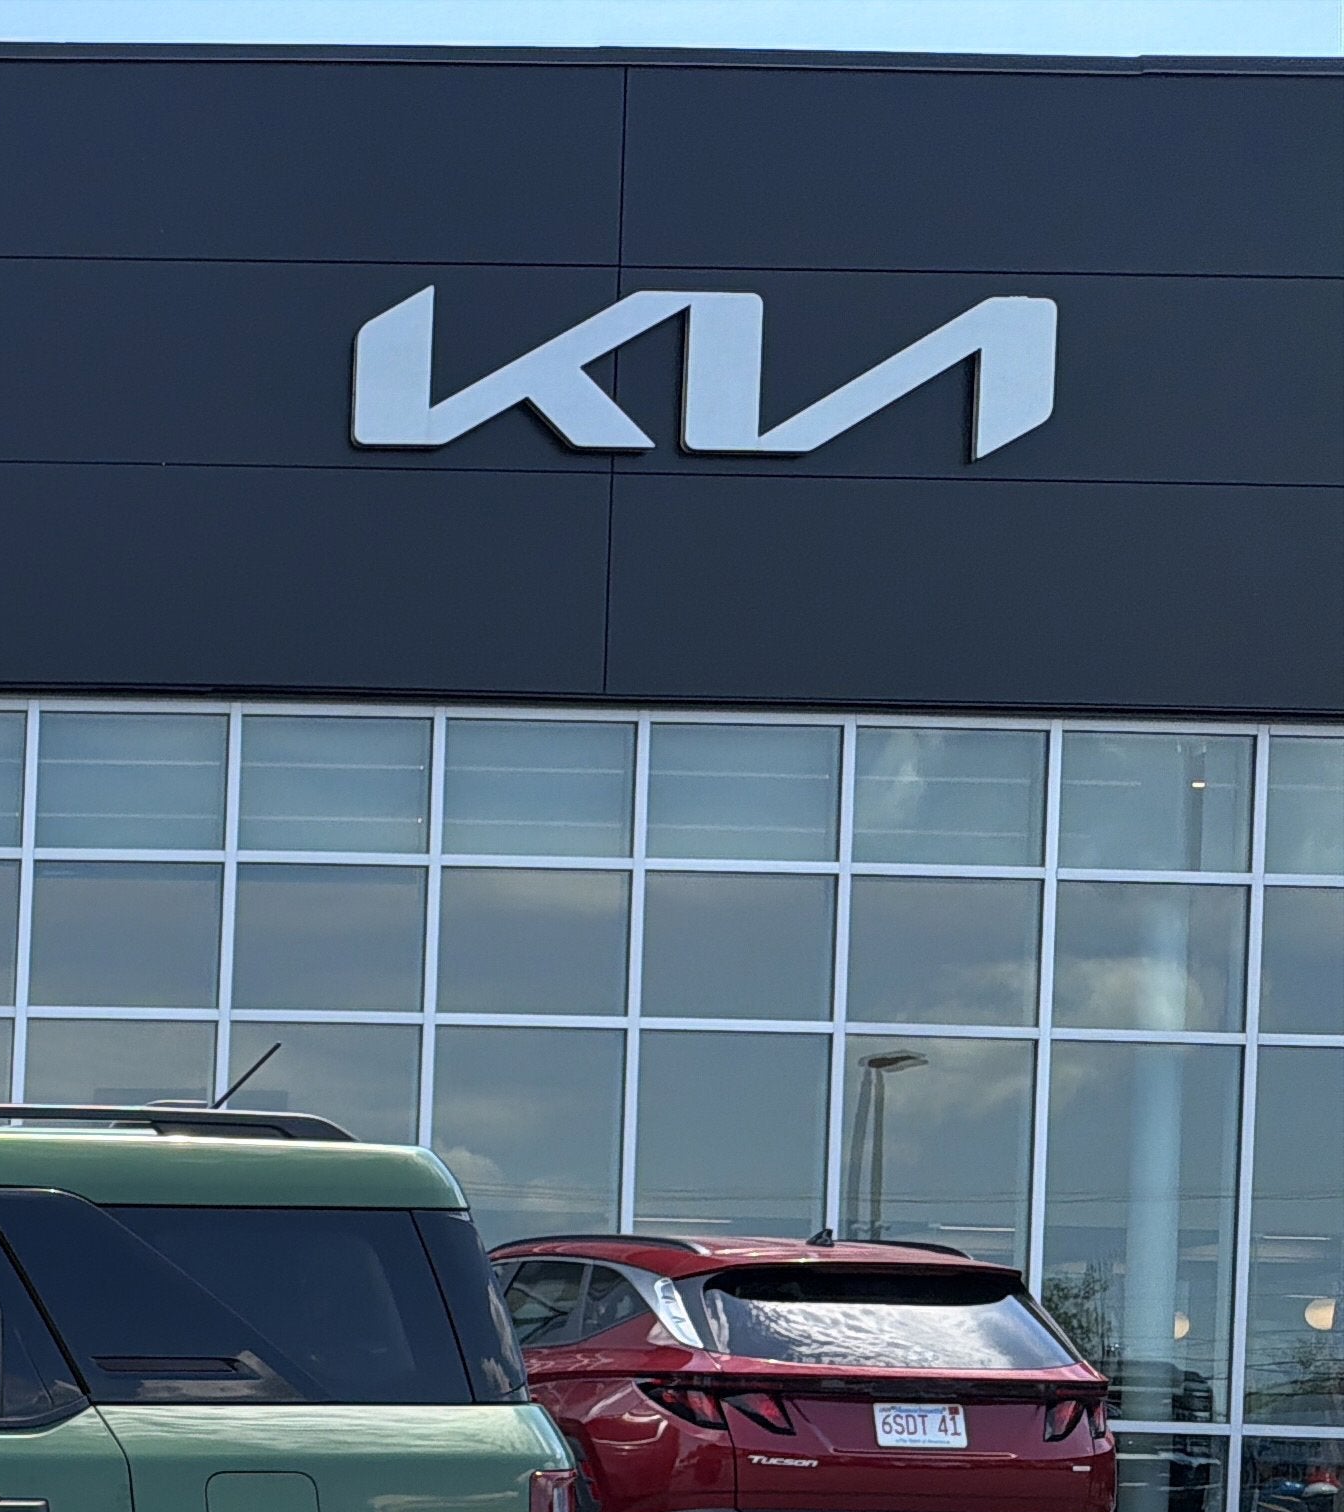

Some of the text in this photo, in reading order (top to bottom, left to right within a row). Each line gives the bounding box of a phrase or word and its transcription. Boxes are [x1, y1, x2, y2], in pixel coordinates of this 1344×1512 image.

[352, 284, 1058, 461] KIA
[881, 1413, 962, 1437] 6SDT 41
